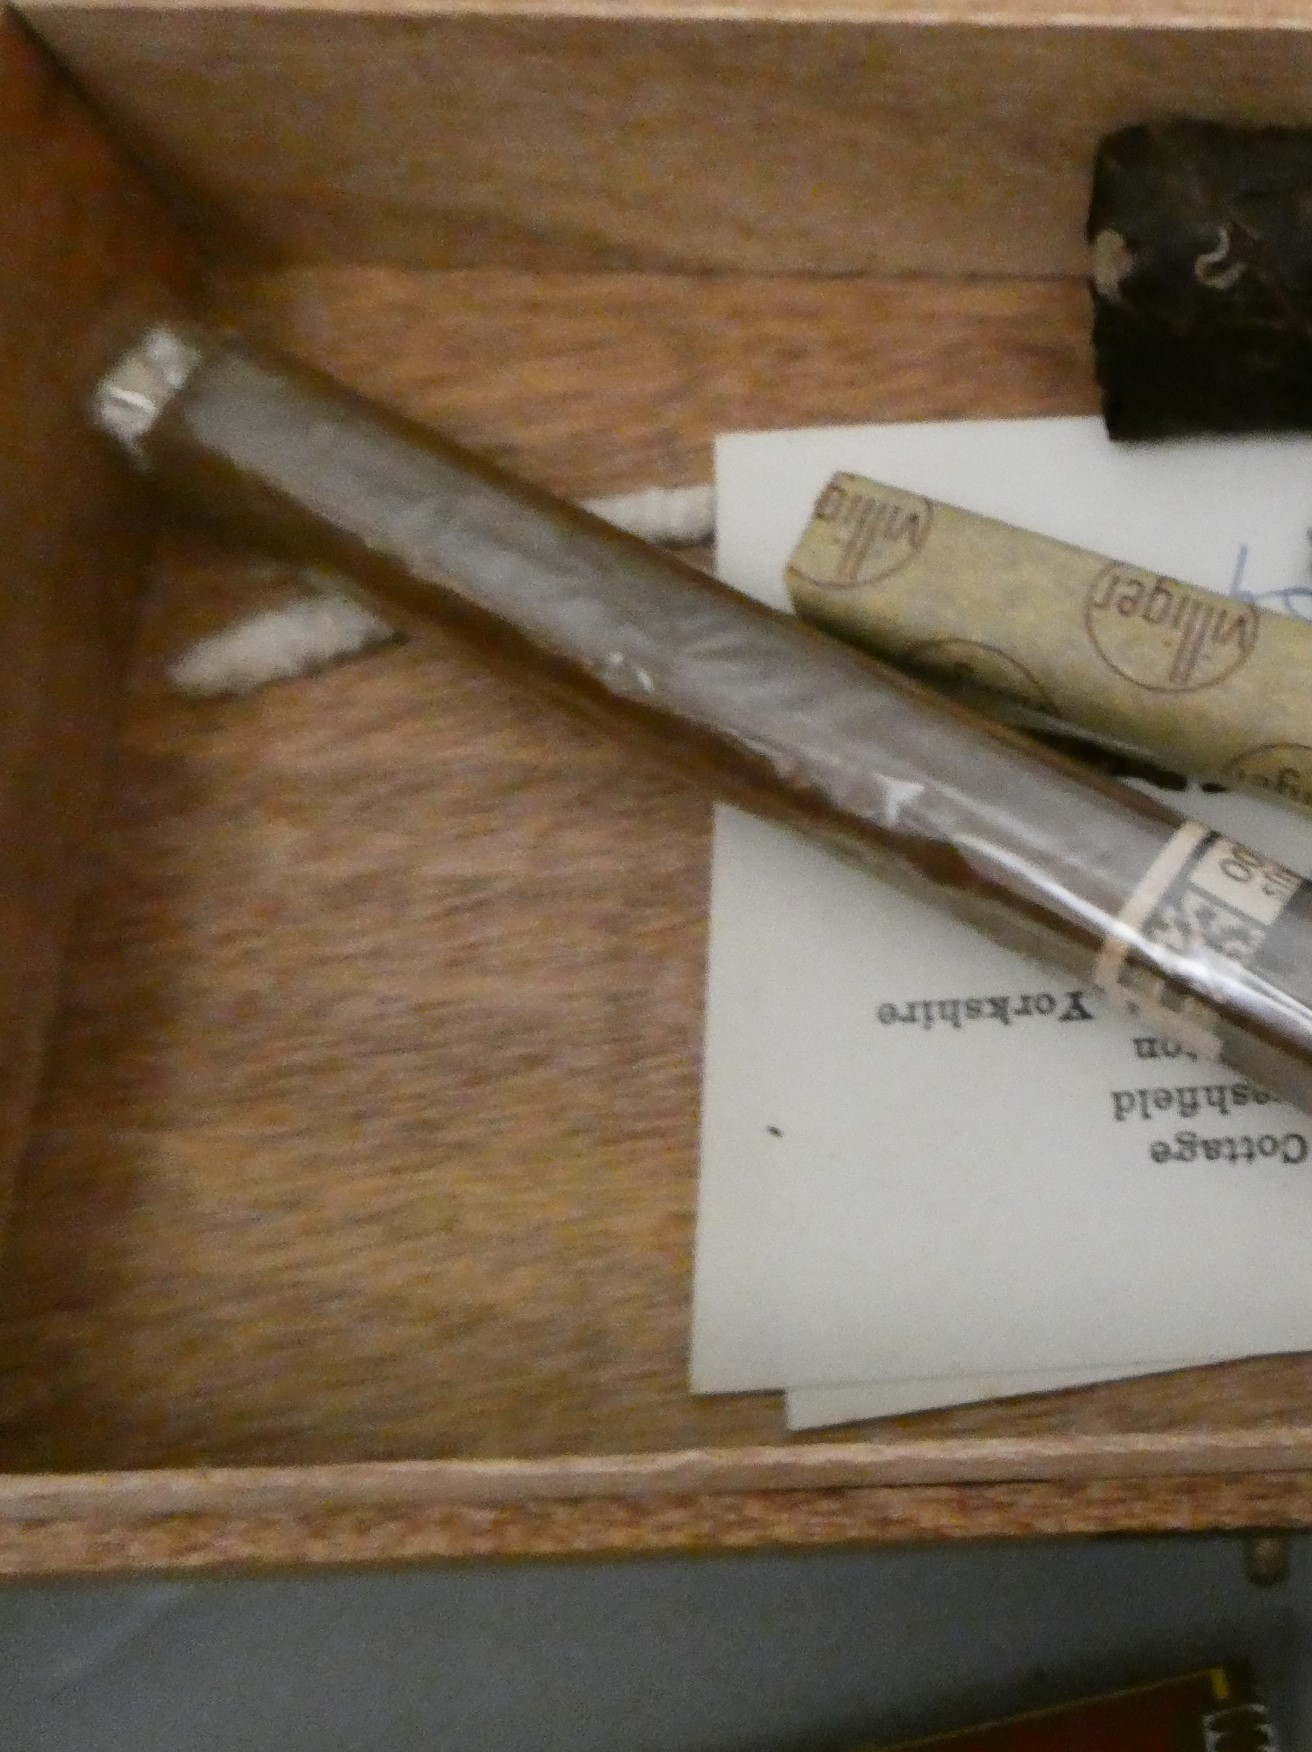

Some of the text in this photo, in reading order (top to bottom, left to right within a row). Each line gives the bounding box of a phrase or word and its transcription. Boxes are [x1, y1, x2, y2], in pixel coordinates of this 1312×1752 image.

[875, 990, 1095, 1032] Yorkshire
[1111, 1081, 1284, 1122] eshfield
[1149, 1131, 1309, 1166] Cottage
